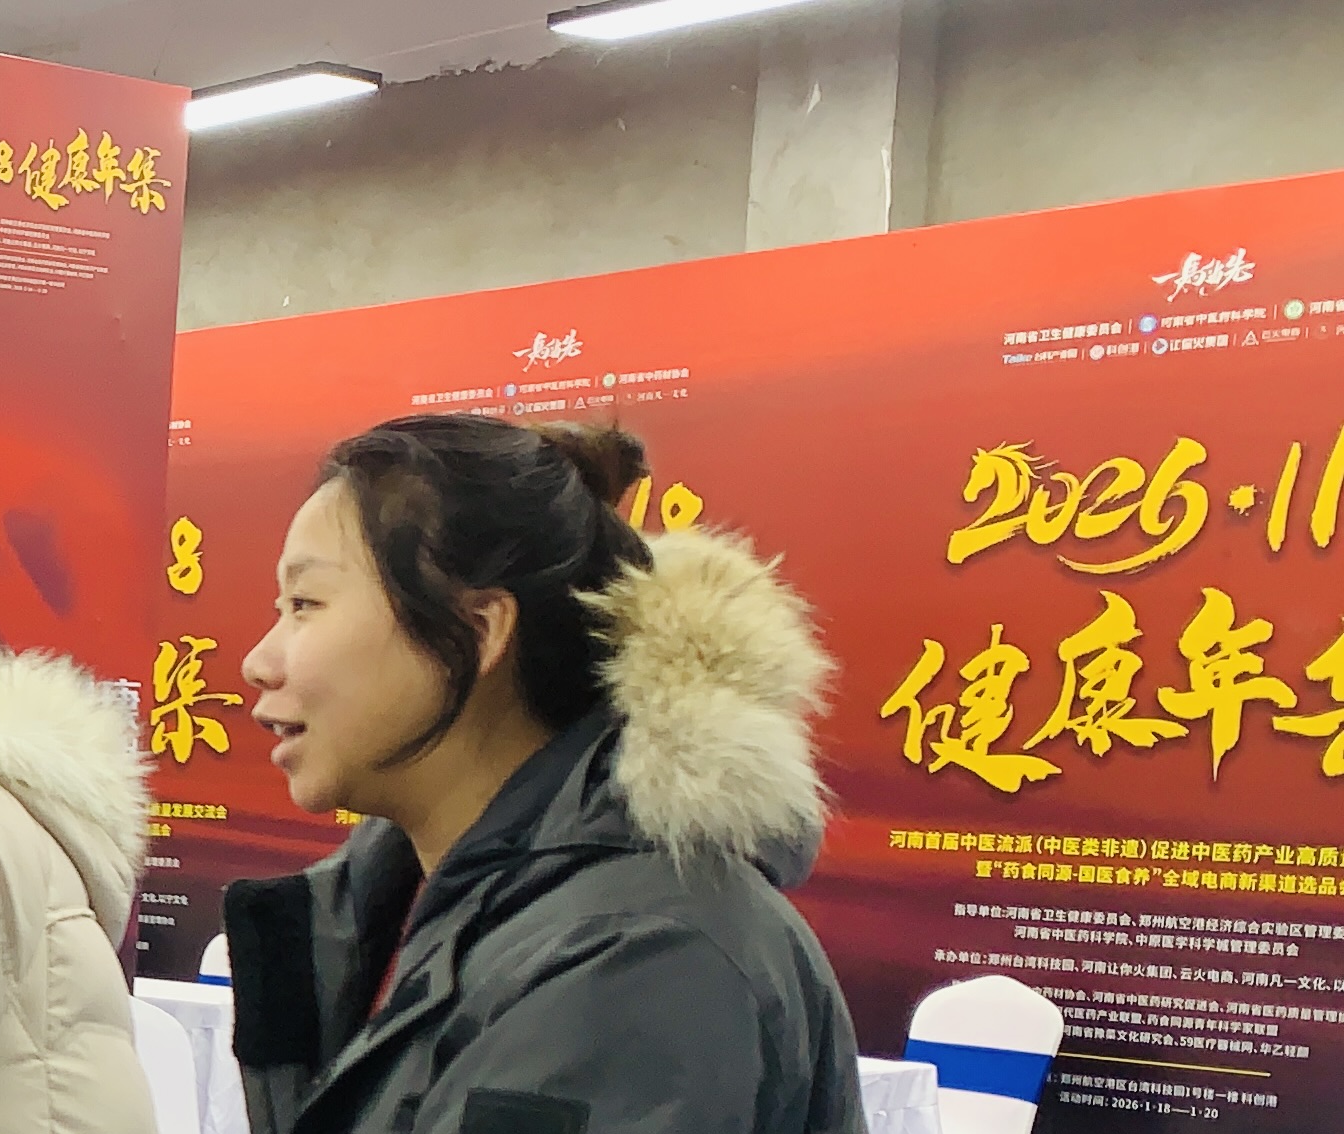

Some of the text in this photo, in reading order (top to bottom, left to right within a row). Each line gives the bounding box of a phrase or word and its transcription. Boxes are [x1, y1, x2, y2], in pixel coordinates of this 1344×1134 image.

[889, 829, 1344, 868] 河南首届中医流派(中医类非遗)促进中医药产业高质
